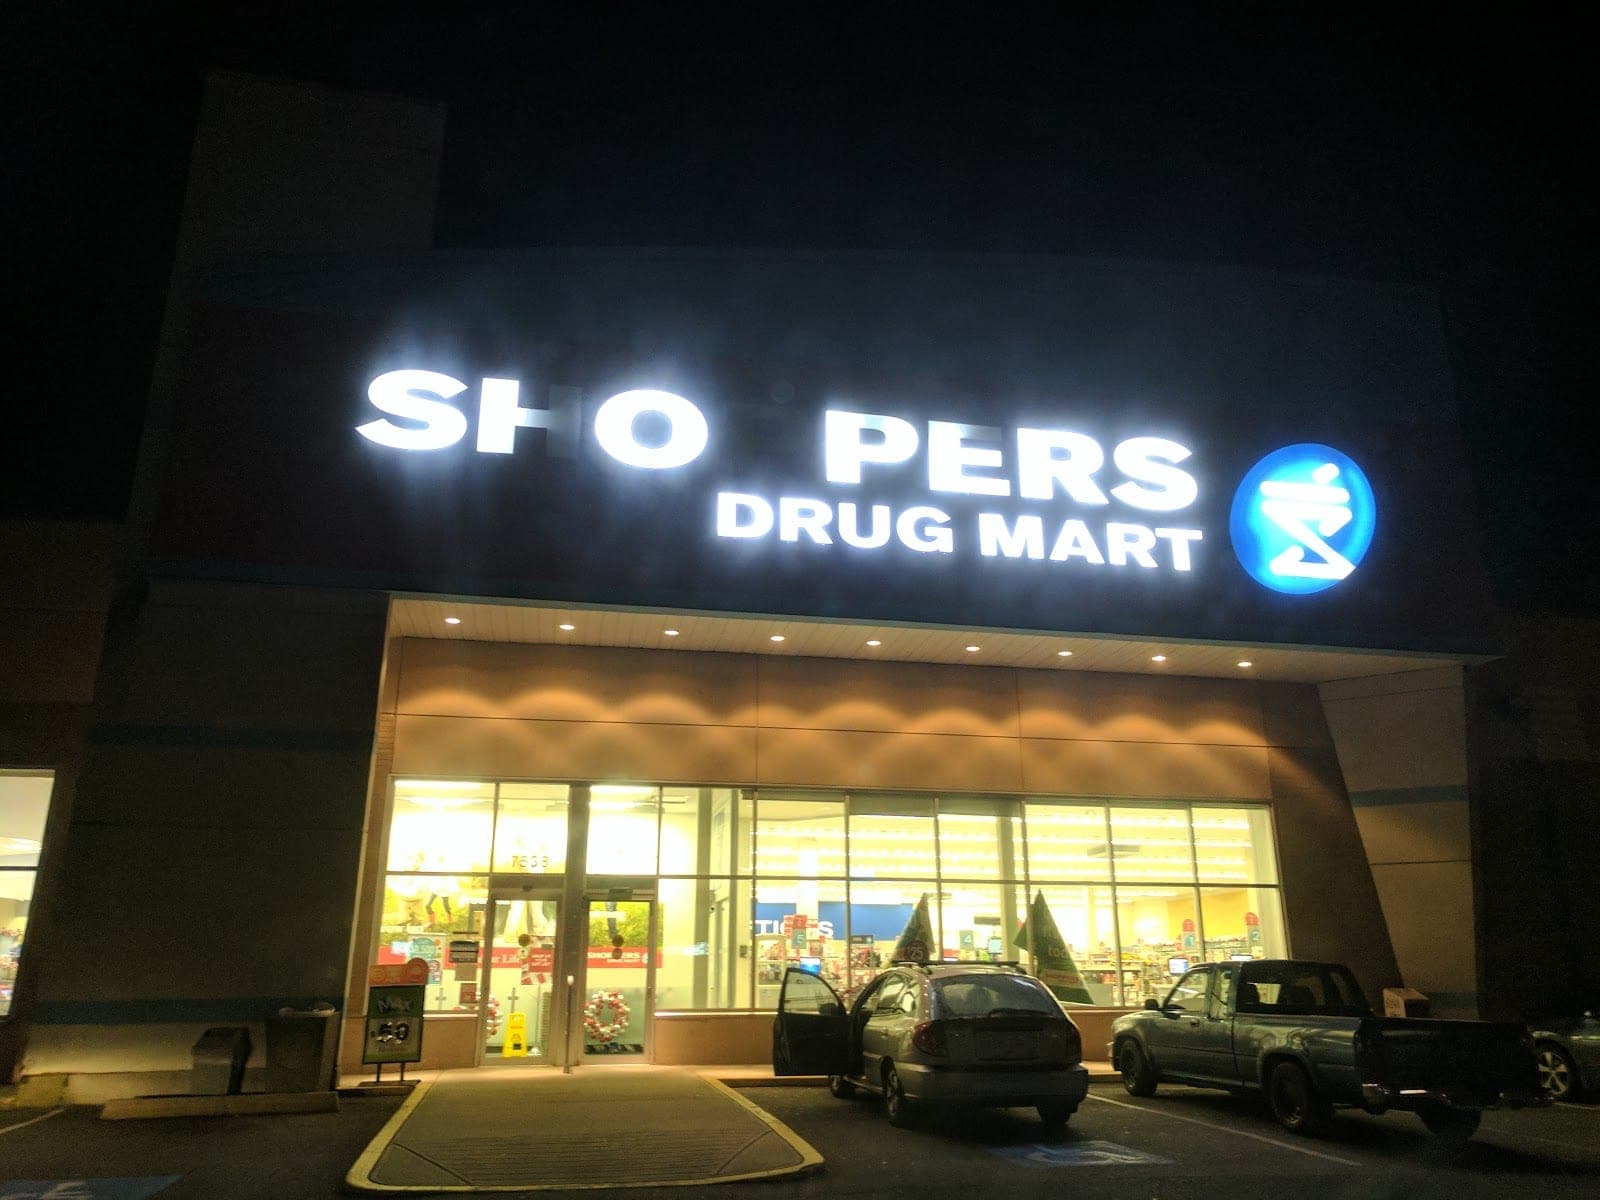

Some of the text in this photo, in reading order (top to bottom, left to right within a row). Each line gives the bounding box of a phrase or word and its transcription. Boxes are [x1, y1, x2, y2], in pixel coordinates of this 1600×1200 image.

[354, 369, 1198, 512] SHOPERS
[716, 491, 1204, 572] DRUG MART
